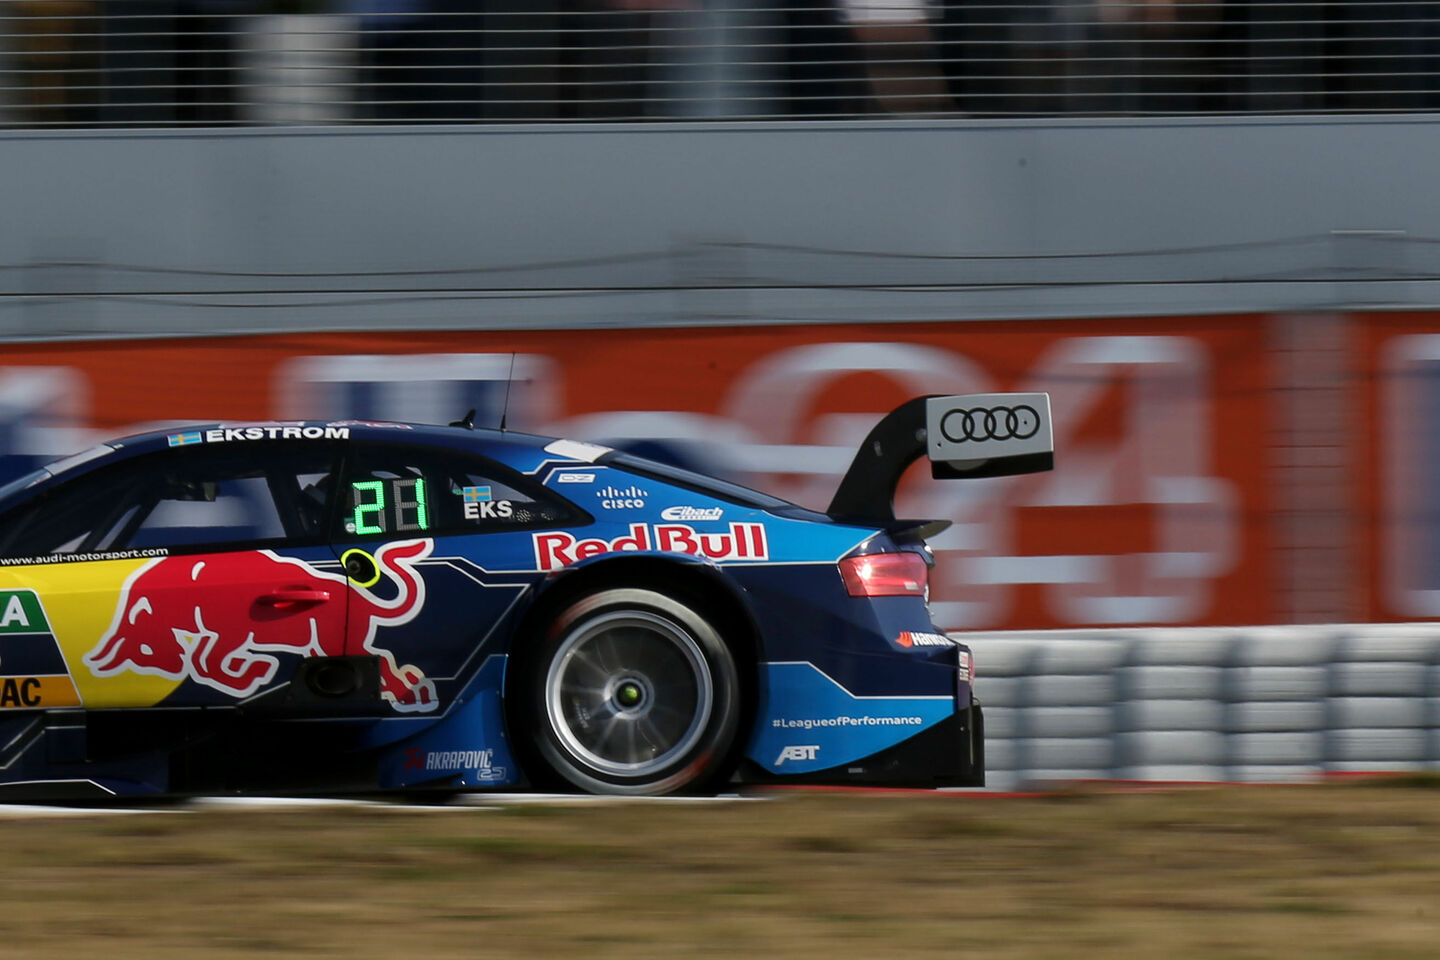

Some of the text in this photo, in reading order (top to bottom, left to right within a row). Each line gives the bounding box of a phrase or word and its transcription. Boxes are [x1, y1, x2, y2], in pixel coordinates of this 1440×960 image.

[207, 427, 350, 442] EKSTROM
[353, 478, 428, 535] 21
[464, 501, 513, 520] EKS
[602, 499, 645, 509] cisco
[661, 506, 724, 520] Eibach
[0, 547, 169, 566] www.audi-motorsport.com
[536, 525, 765, 570] Red Bull
[772, 716, 923, 729] #LeagueofPerformance
[774, 745, 820, 766] ABT
